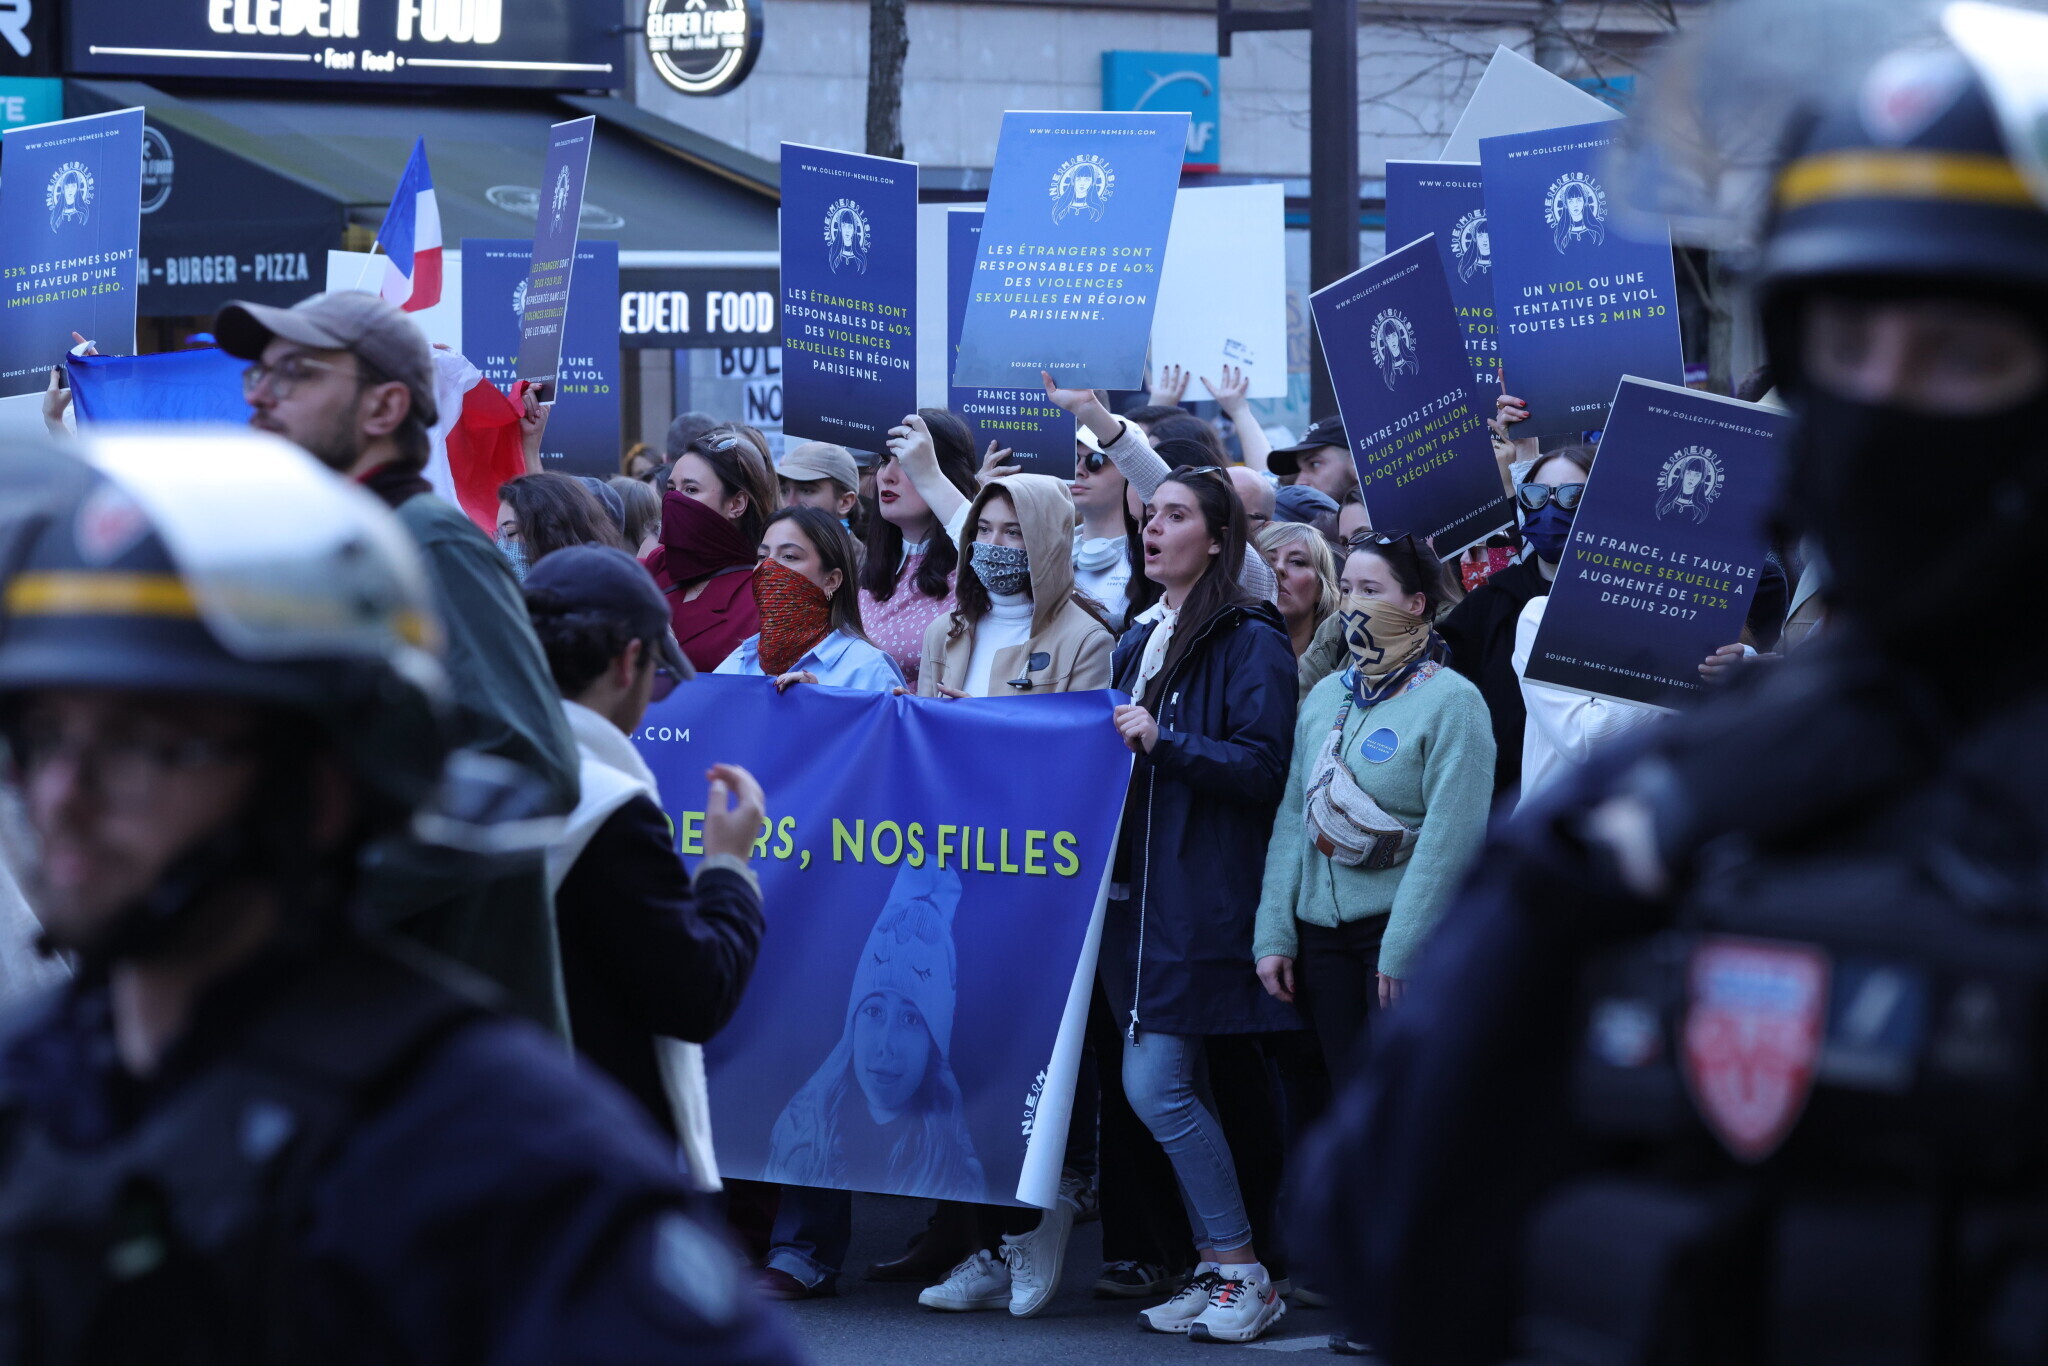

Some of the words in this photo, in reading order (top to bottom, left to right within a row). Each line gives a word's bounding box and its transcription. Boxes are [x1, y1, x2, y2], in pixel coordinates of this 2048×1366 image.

[324, 48, 355, 70] Fast
[362, 50, 394, 72] Food
[25, 130, 119, 150] WWW.COLLECTIF-NEMESIS.COM
[1029, 128, 1156, 136] WWW.COLLECTIF-NEMESIS.COM
[46, 161, 94, 207] NEMESIS
[801, 164, 894, 184] WWW.COLLECTIF-NEMESIS.COM
[1049, 154, 1116, 196] NEMESIS
[1419, 180, 1482, 188] WWW.COLLECT
[1544, 172, 1606, 224] NEMESIS
[824, 198, 870, 240] NEMESIS
[4, 267, 26, 278] 53%
[31, 262, 51, 274] DES
[55, 254, 100, 270] FEMMES
[104, 249, 133, 263] SONT
[988, 245, 1013, 255] LES
[1018, 243, 1106, 256] ÉTRANGERS
[1112, 247, 1152, 257] SONT
[166, 255, 237, 285] BURGER
[255, 252, 309, 282] PIZZA
[979, 261, 1093, 272] RESPONSABLES
[1099, 263, 1118, 272] DE
[1123, 263, 1154, 273] 40%
[7, 287, 87, 308] IMMIGRATION
[92, 281, 124, 295] ZÉRO.
[17, 281, 30, 292] EN
[34, 274, 78, 289] FAVEUR
[1004, 277, 1032, 287] DES
[1038, 278, 1124, 288] VIOLENCES
[1336, 263, 1419, 310] WWW.COLLECTIF-NEMESIS.COM
[1524, 285, 1543, 298] UN
[1549, 280, 1584, 294] VIOL
[1589, 276, 1610, 289] OU
[1616, 272, 1644, 285] UNE
[788, 288, 806, 300] LES
[810, 290, 874, 312] ÉTRANGERS
[878, 304, 908, 318] SONT
[976, 292, 1058, 304] SEXUELLES
[1063, 294, 1082, 304] EN
[1088, 292, 1147, 304] RÉGION
[1514, 296, 1594, 316] TENTATIVE
[1600, 293, 1617, 306] DE
[1622, 288, 1658, 302] VIOL
[620, 291, 690, 334] EVEN
[706, 291, 774, 334] FOOD
[785, 304, 867, 328] RESPONSABLES
[871, 320, 884, 332] DE
[888, 324, 912, 336] 40%
[1010, 309, 1105, 320] PARISIENNE.
[1510, 318, 1565, 334] TOUTES
[1570, 314, 1594, 327] LES
[1600, 313, 1608, 323] 2
[1614, 308, 1642, 322] MIN
[1648, 305, 1666, 317] 30
[805, 325, 824, 337] DES
[828, 329, 891, 350] VIOLENCES
[1370, 308, 1412, 365] NEMESIS
[487, 356, 504, 365] UN
[569, 358, 594, 366] UNE
[721, 348, 780, 375] BOL
[786, 338, 846, 358] SEXUELLES
[850, 350, 862, 361] EN
[867, 352, 910, 370] RÉGION
[1011, 361, 1042, 369] SOURCE
[2, 369, 26, 378] SOURCE
[573, 371, 603, 380] VIOL
[813, 360, 882, 382] PARISIENNE.
[564, 385, 588, 394] MIN
[593, 385, 610, 394] 30
[748, 385, 783, 421] NO
[978, 390, 1017, 400] FRANCE
[1020, 392, 1046, 402] SONT
[963, 404, 1017, 415] COMMISES
[1020, 407, 1039, 416] PAR
[1043, 408, 1061, 418] DES
[1360, 426, 1392, 450] ENTRE
[1394, 411, 1420, 432] 2012
[1422, 402, 1434, 416] ET
[1437, 388, 1467, 409] 2023,
[1570, 404, 1601, 412] SOURCE
[821, 416, 844, 426] SOURCE
[848, 422, 871, 431] EUROPE
[980, 420, 1042, 432] ETRANGERS.
[1368, 444, 1394, 464] PLUS
[1424, 404, 1468, 434] MILLION
[1441, 428, 1460, 444] PAS
[1462, 414, 1480, 433] ÉTÉ
[1648, 406, 1774, 438] WWW.COLLECTIF-NEMESIS.COM
[1396, 449, 1458, 488] EXÉCUTÉES.
[1657, 446, 1725, 487] NEMESIS
[1455, 518, 1464, 526] VIA
[1466, 510, 1478, 521] AVIS
[1575, 532, 1595, 544] EN
[1600, 536, 1664, 562] FRANCE,
[1670, 551, 1688, 564] LE
[1694, 556, 1732, 574] TAUX
[1736, 566, 1756, 580] DE
[1576, 550, 1652, 575] VIOLENCE
[1657, 567, 1730, 592] SEXUELLE
[1734, 584, 1744, 594] A
[1578, 569, 1664, 596] AUGMENTÉ
[1668, 588, 1688, 600] DE
[1693, 593, 1728, 610] 112%
[1601, 592, 1654, 612] DEPUIS
[1660, 604, 1698, 620] 2017
[1545, 652, 1577, 664] SOURCE
[1584, 660, 1606, 671] MARC
[1608, 666, 1651, 680] VANGUARD
[1654, 675, 1666, 684] VIA
[832, 818, 925, 867] NOS
[938, 824, 1080, 877] FILLES
